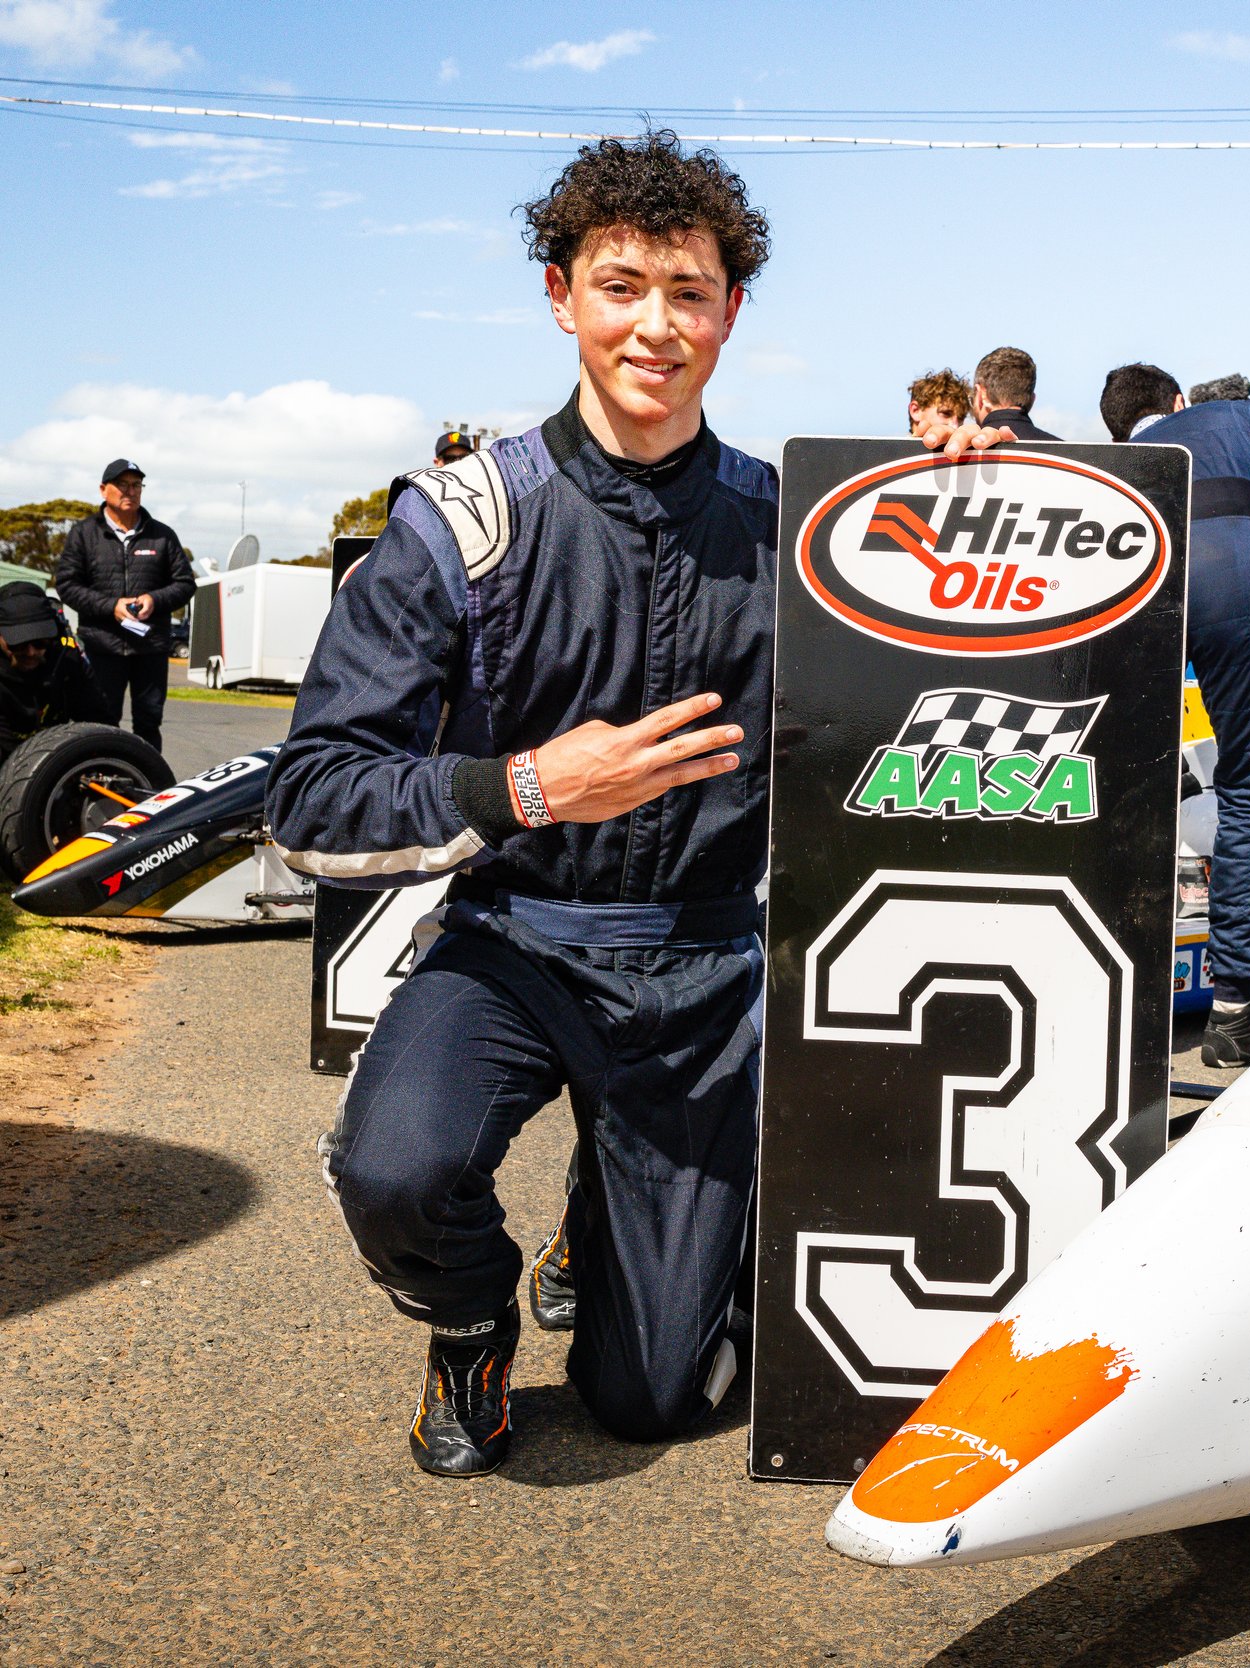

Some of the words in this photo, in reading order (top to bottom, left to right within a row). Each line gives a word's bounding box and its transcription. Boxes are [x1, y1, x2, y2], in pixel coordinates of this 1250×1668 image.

[932, 496, 1147, 560] Hi-Tec
[929, 561, 1048, 612] Oils
[513, 769, 537, 818] SUPER
[524, 767, 549, 818] SERIES
[846, 747, 1098, 822] AASA
[124, 832, 199, 881] YOKOHAMA
[796, 869, 1134, 1399] 3
[893, 1423, 1020, 1473] SPECTRUM
